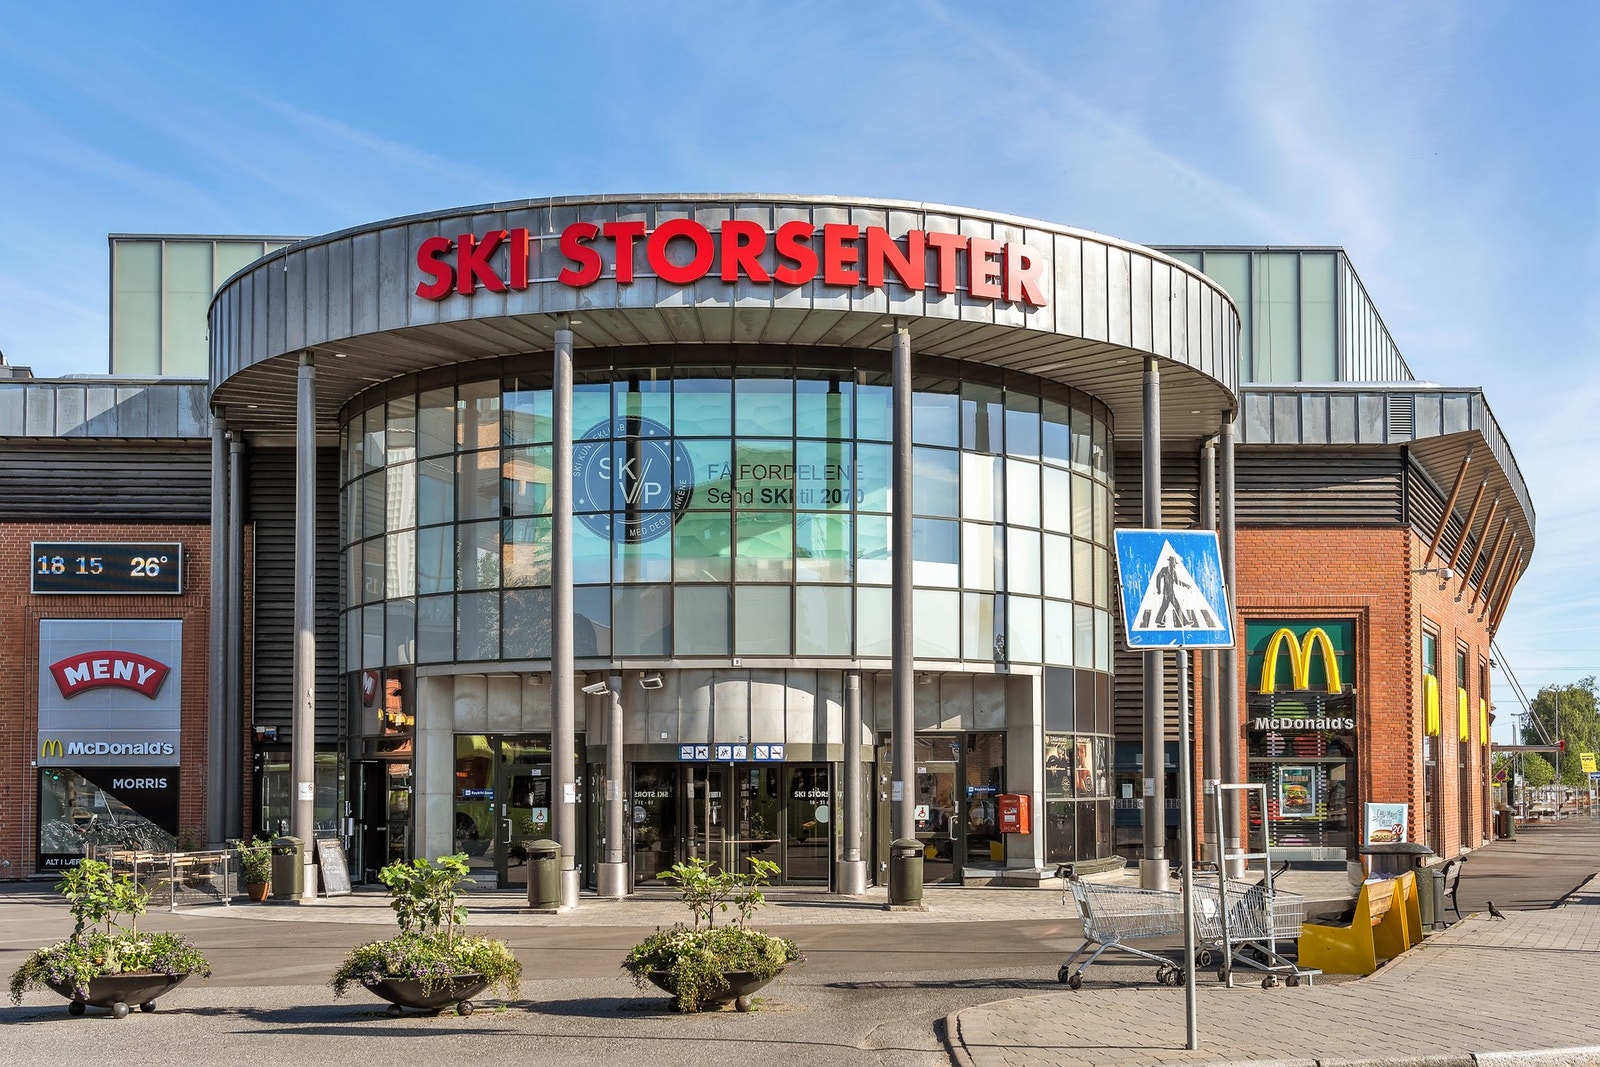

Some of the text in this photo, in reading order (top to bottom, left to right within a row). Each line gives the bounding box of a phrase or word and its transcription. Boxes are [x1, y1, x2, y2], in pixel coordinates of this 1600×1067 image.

[415, 218, 1047, 307] SKI STORSENTER
[572, 461, 585, 477] SKI
[708, 461, 864, 481] FÅ FORDELENE
[707, 487, 865, 504] Send SKI til 2070
[629, 527, 648, 537] MED
[650, 518, 667, 532] DEG
[37, 555, 168, 577] 18 15 26°
[63, 659, 156, 687] MENY
[1254, 717, 1354, 730] McDonald's
[67, 742, 174, 755] McDonald's
[113, 778, 167, 789] MORRIS
[1392, 825, 1403, 835] 20
[45, 858, 58, 866] ALT
